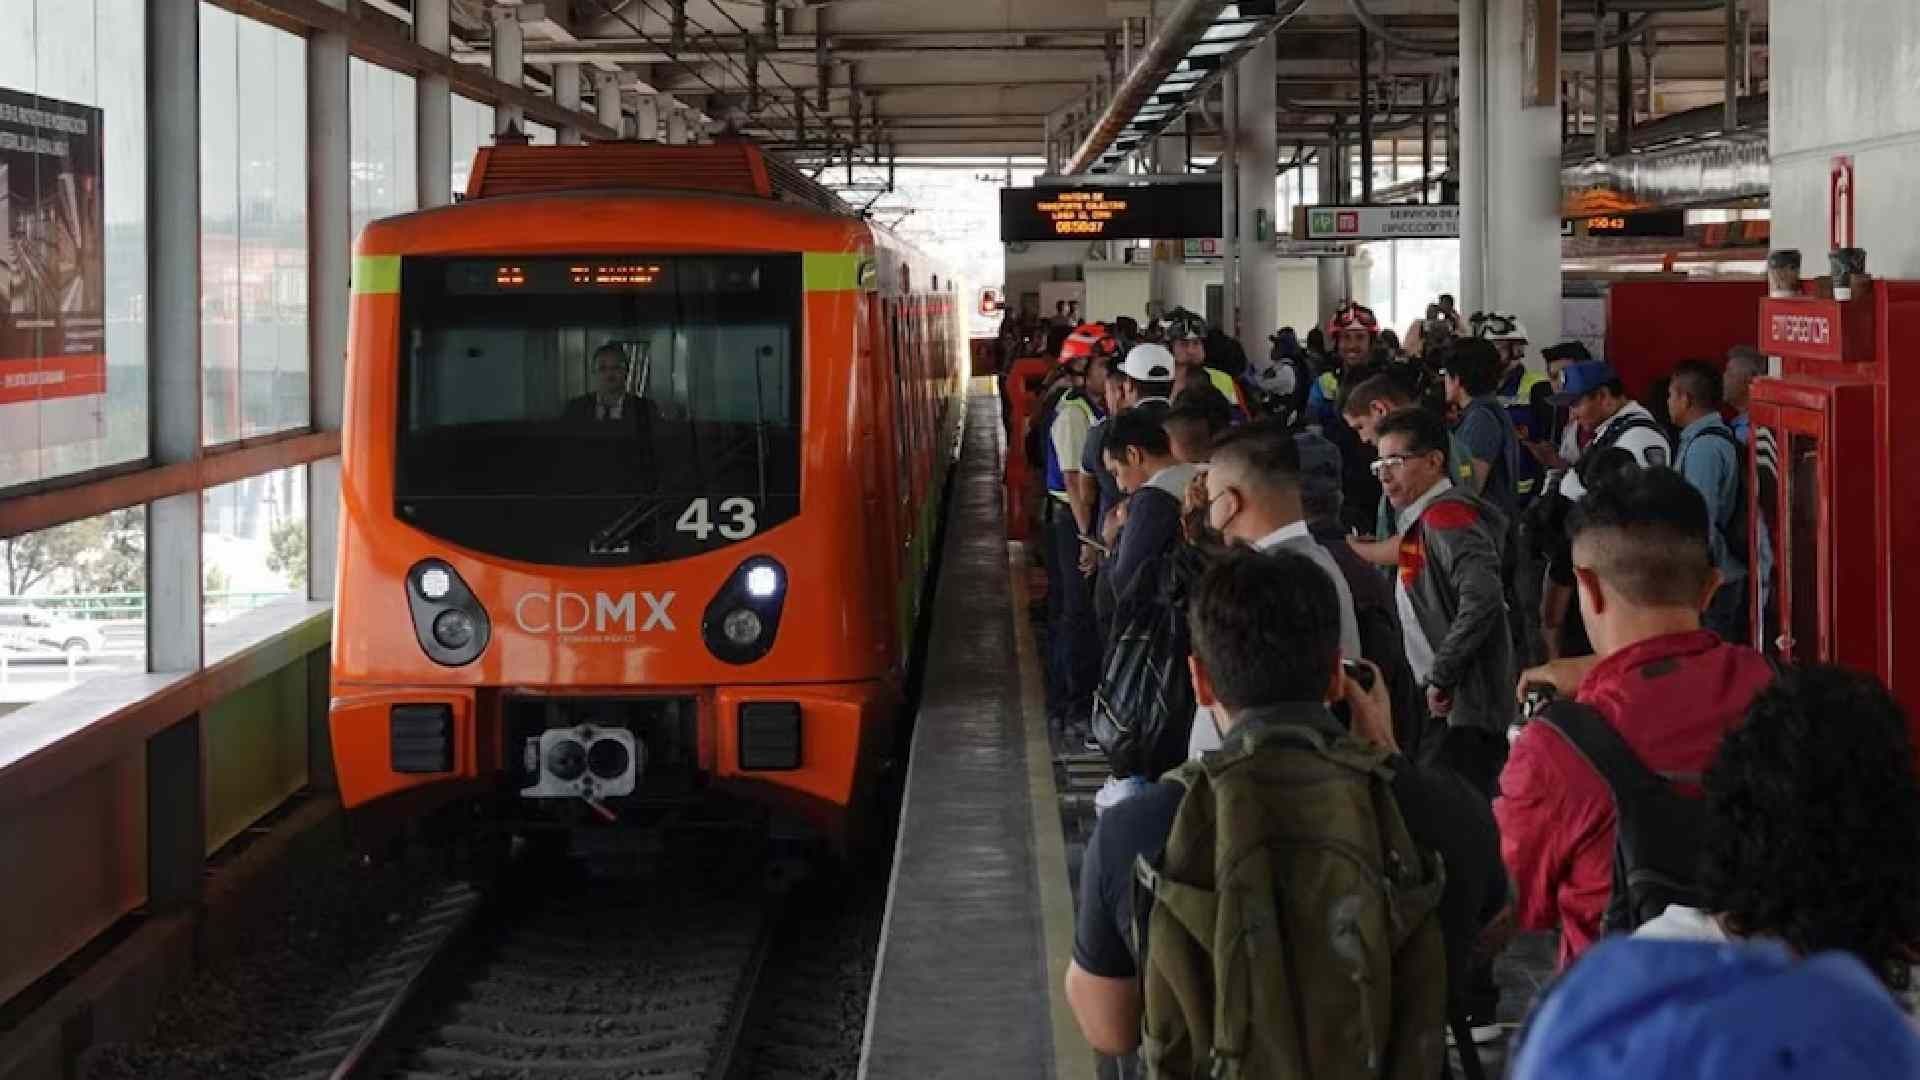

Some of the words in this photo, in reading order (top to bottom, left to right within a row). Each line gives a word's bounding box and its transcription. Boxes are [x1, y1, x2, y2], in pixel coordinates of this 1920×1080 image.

[1389, 209, 1437, 219] SERVICIO
[675, 497, 758, 540] 43
[514, 591, 678, 633] CDMX
